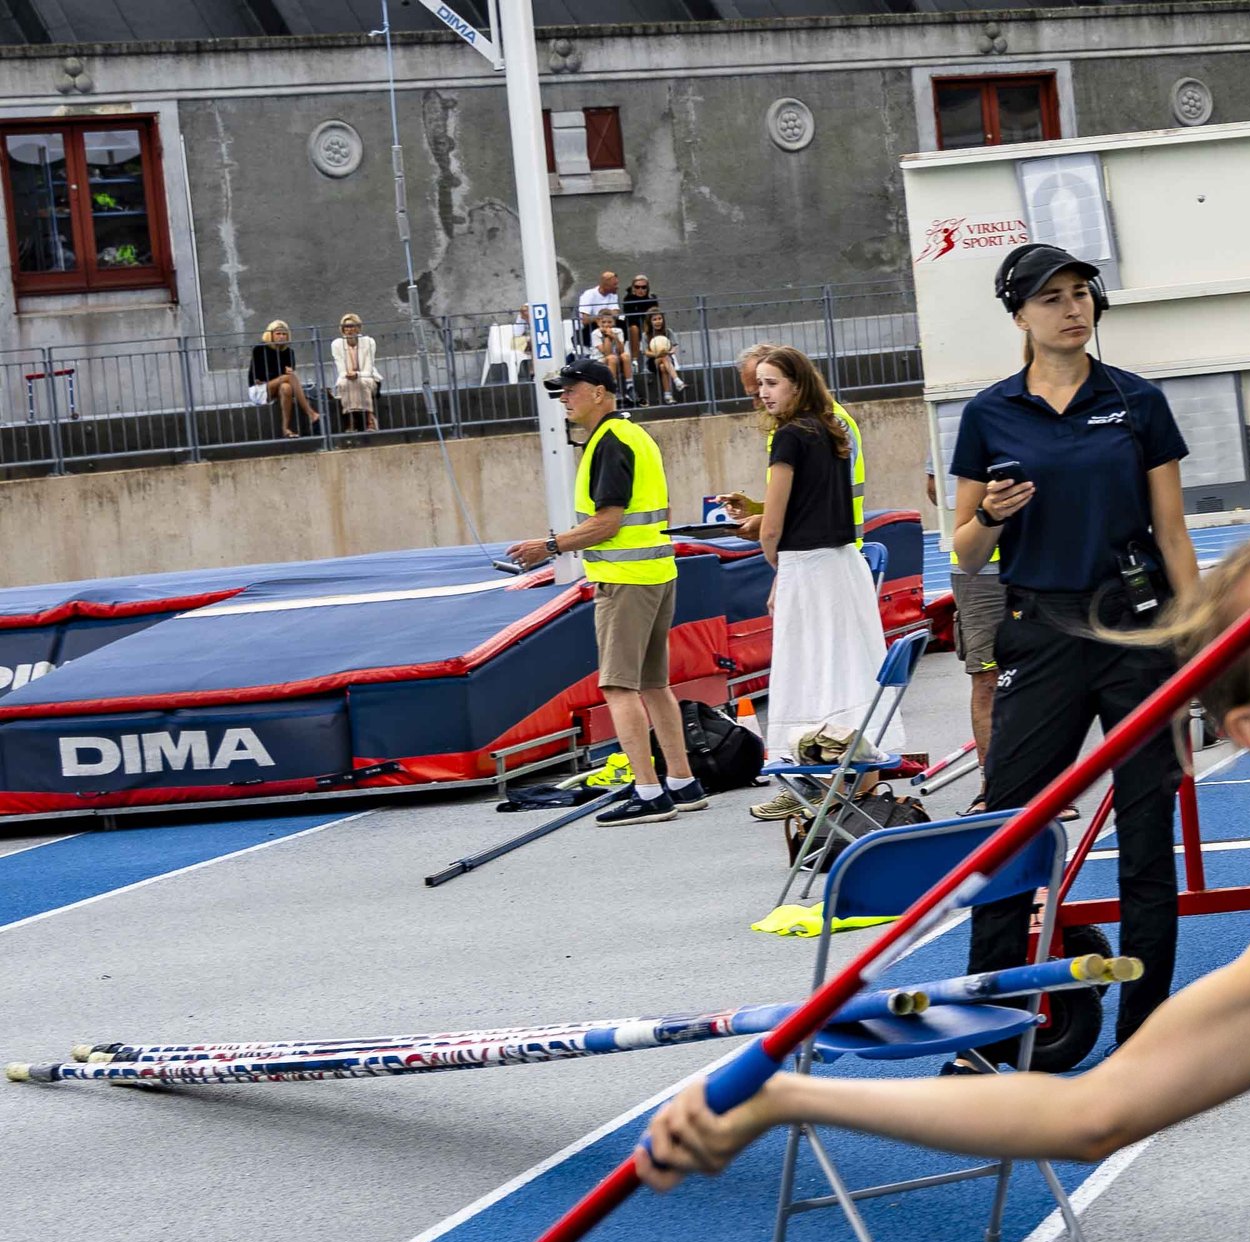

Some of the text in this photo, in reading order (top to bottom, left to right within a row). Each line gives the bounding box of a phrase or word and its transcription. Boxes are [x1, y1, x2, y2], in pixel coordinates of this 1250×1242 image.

[437, 5, 476, 44] DIMA
[963, 235, 1004, 249] SPORT
[534, 306, 550, 357] DIMA
[59, 727, 276, 777] DIMA
